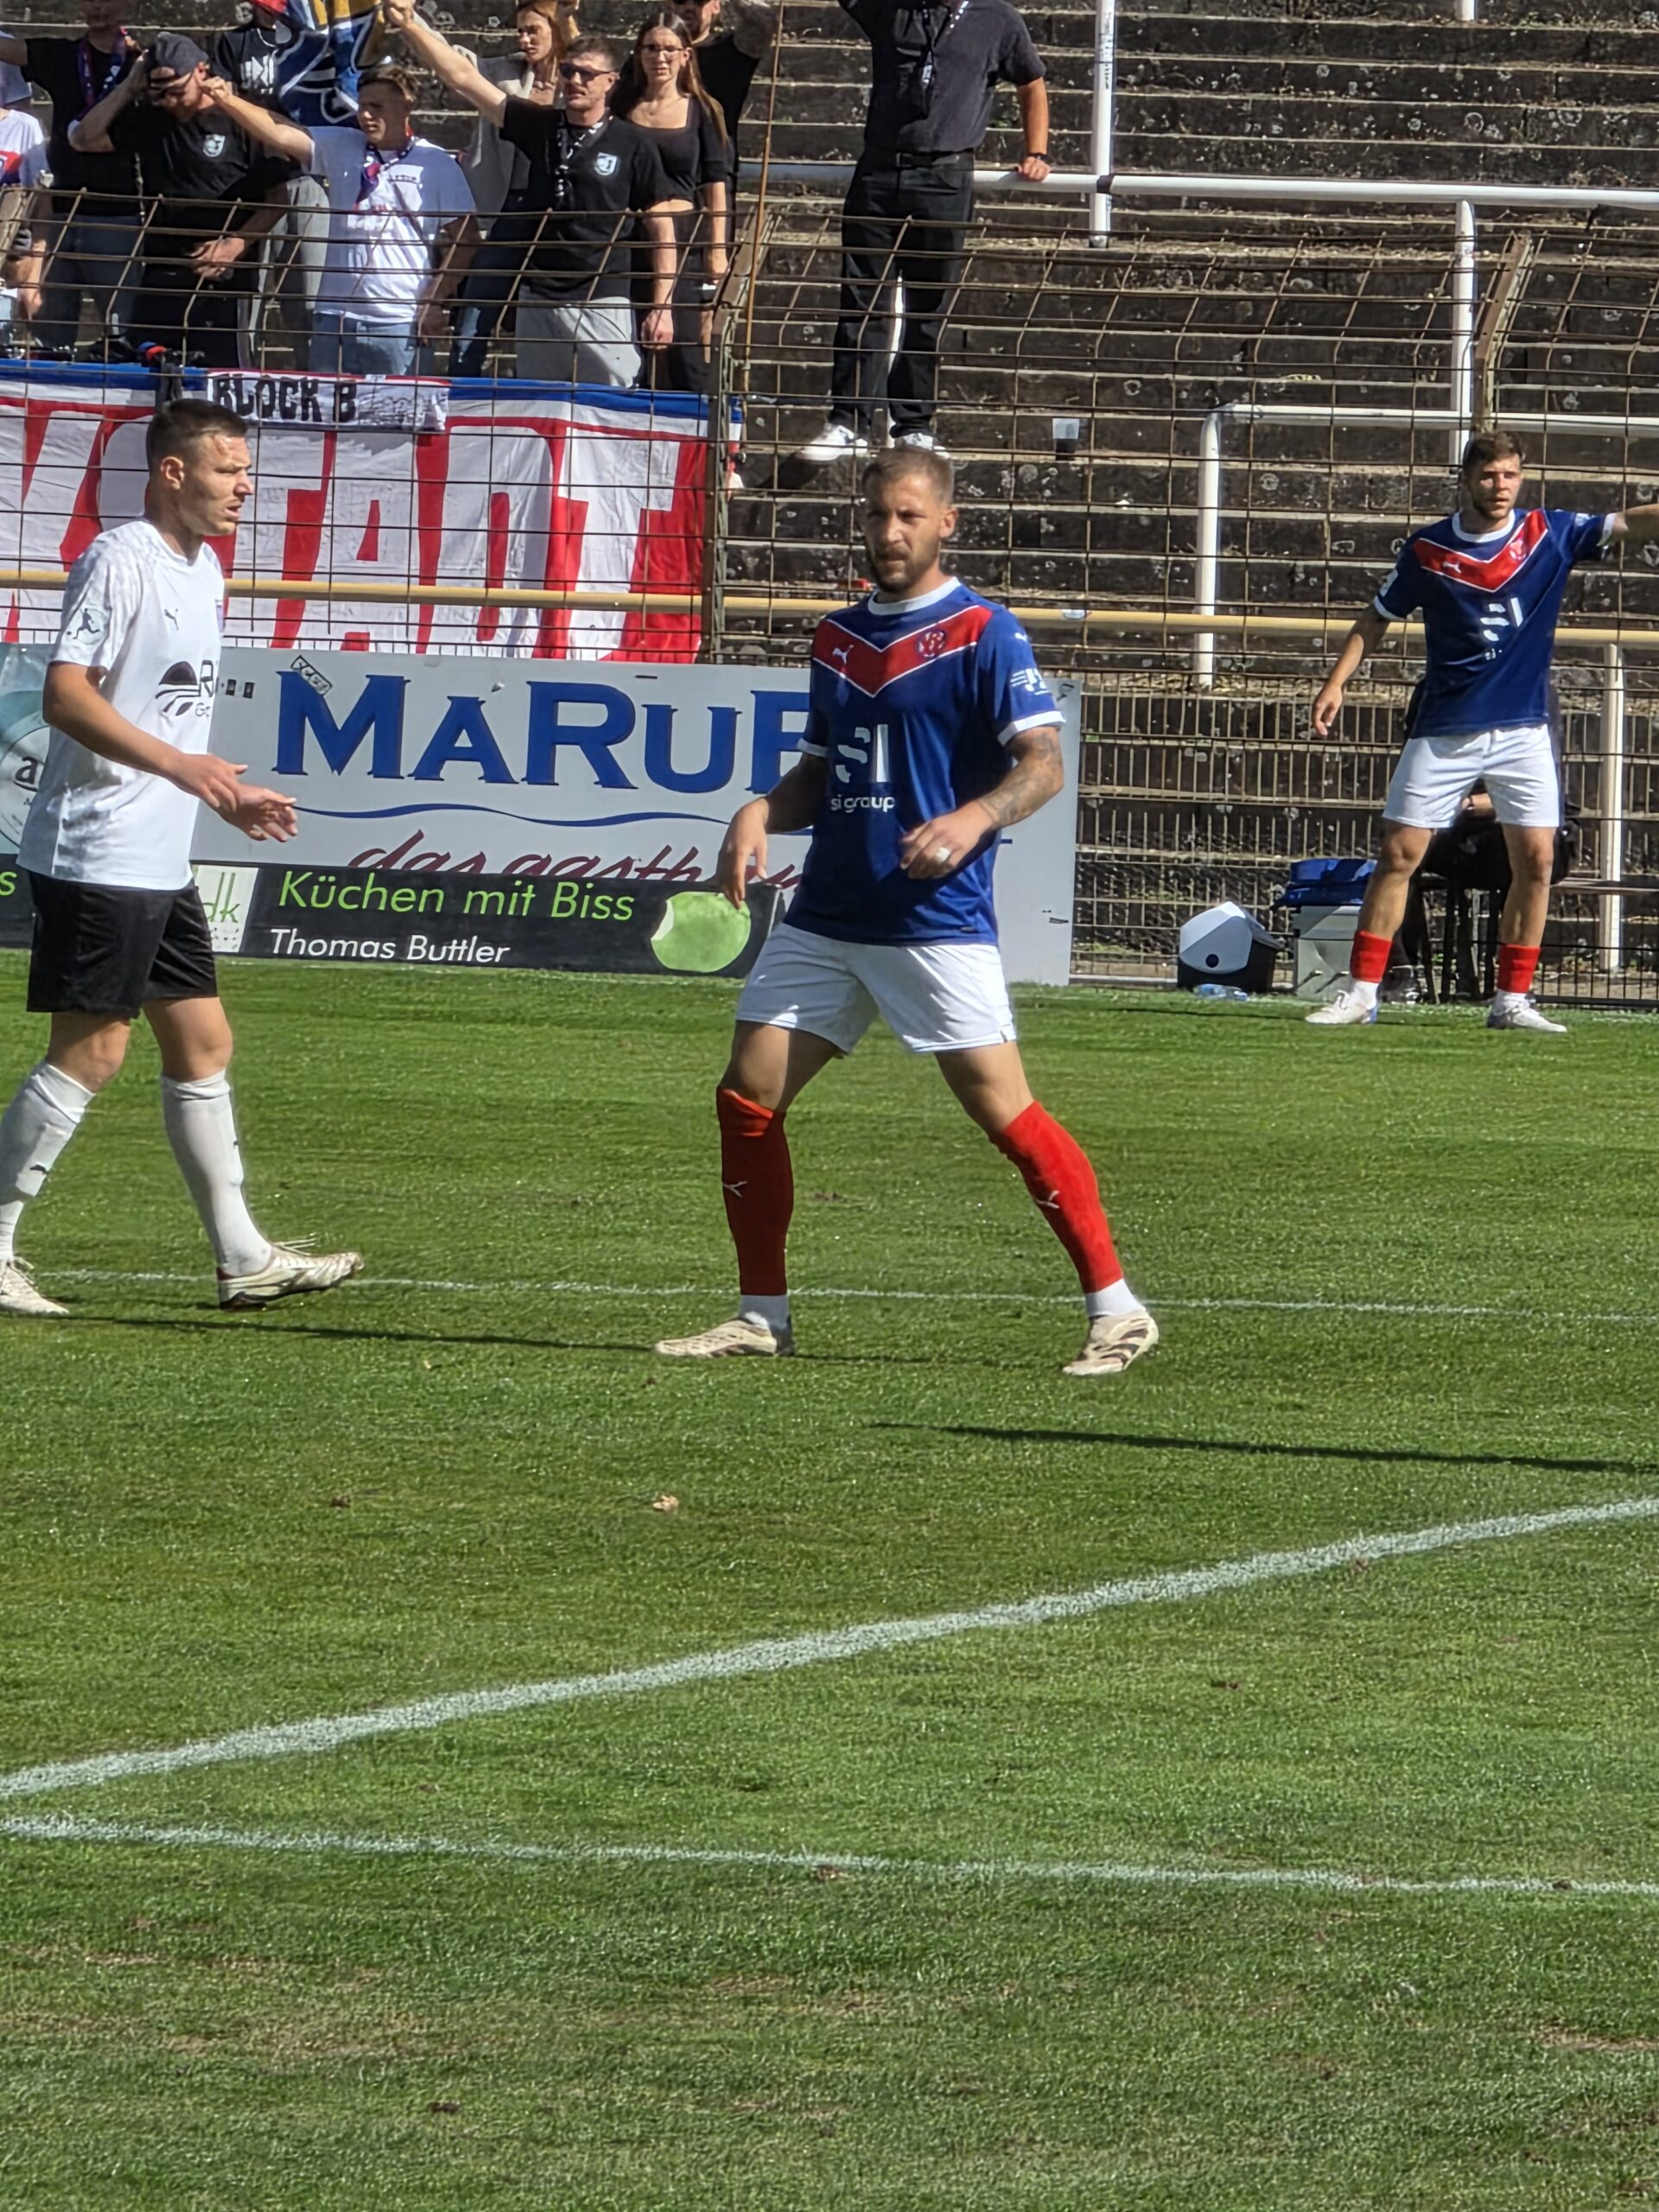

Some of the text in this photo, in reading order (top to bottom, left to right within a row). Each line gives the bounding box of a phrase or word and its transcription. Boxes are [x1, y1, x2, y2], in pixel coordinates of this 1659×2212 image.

[216, 373, 358, 423] BLOCK B
[278, 870, 635, 922] Küchen mit Biss
[270, 928, 397, 959] Thomas
[407, 934, 512, 963] Buttler
